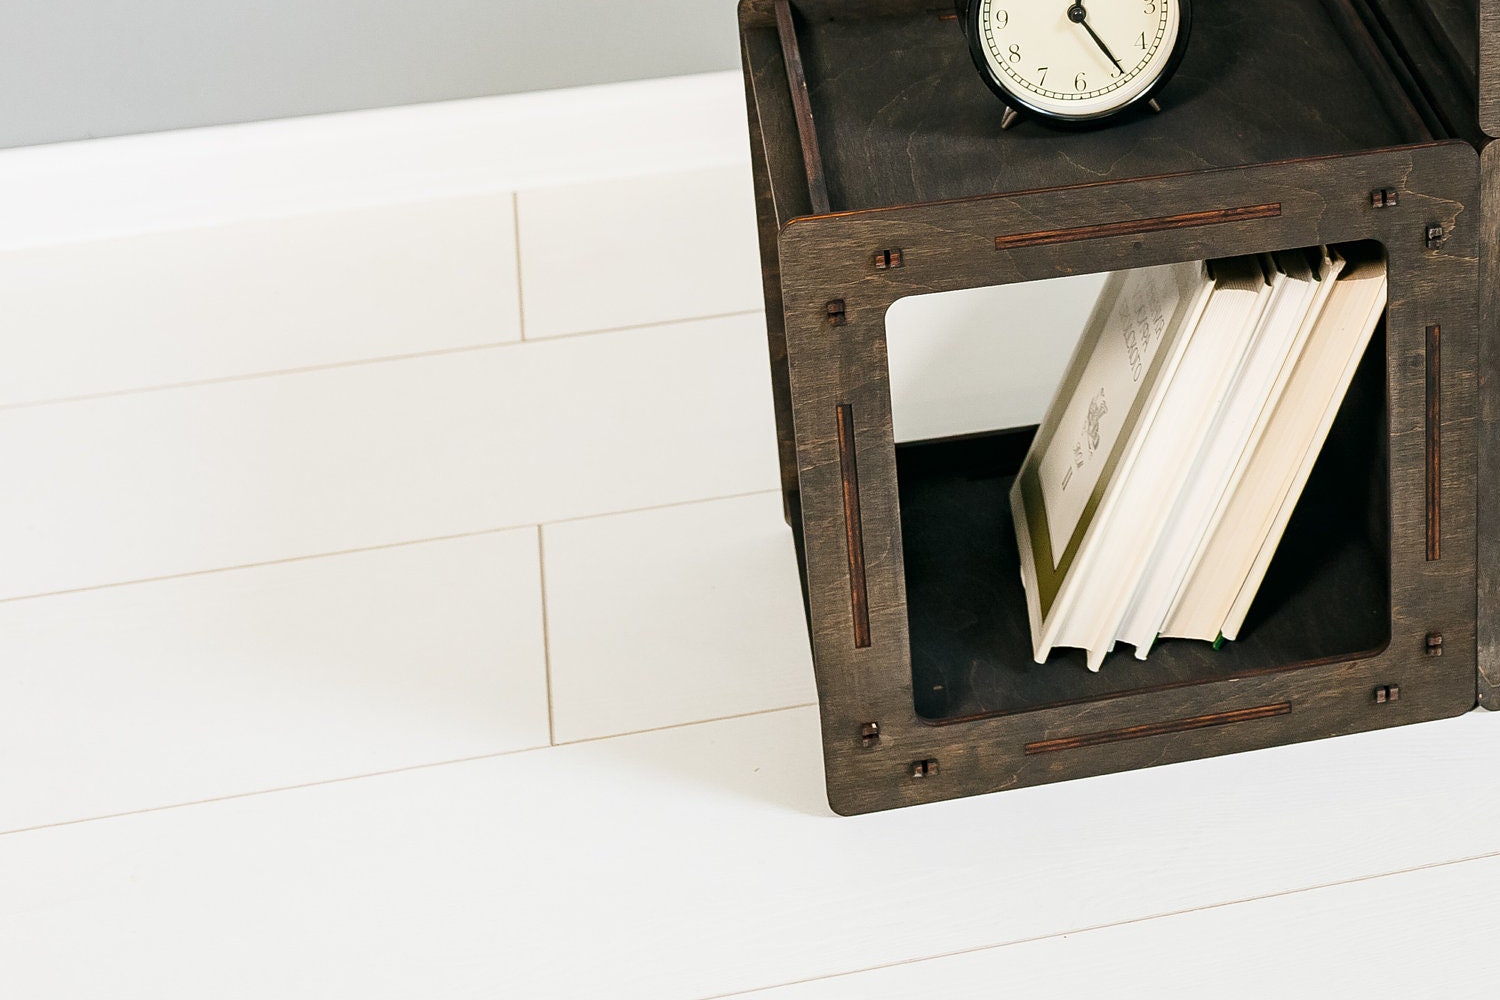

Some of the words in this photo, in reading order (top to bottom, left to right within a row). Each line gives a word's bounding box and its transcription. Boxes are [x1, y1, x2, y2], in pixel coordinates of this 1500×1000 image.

[996, 11, 1008, 29] 9
[1133, 32, 1148, 50] 4
[1009, 44, 1021, 63] 8
[1037, 67, 1048, 87] 7
[1075, 73, 1086, 91] 6
